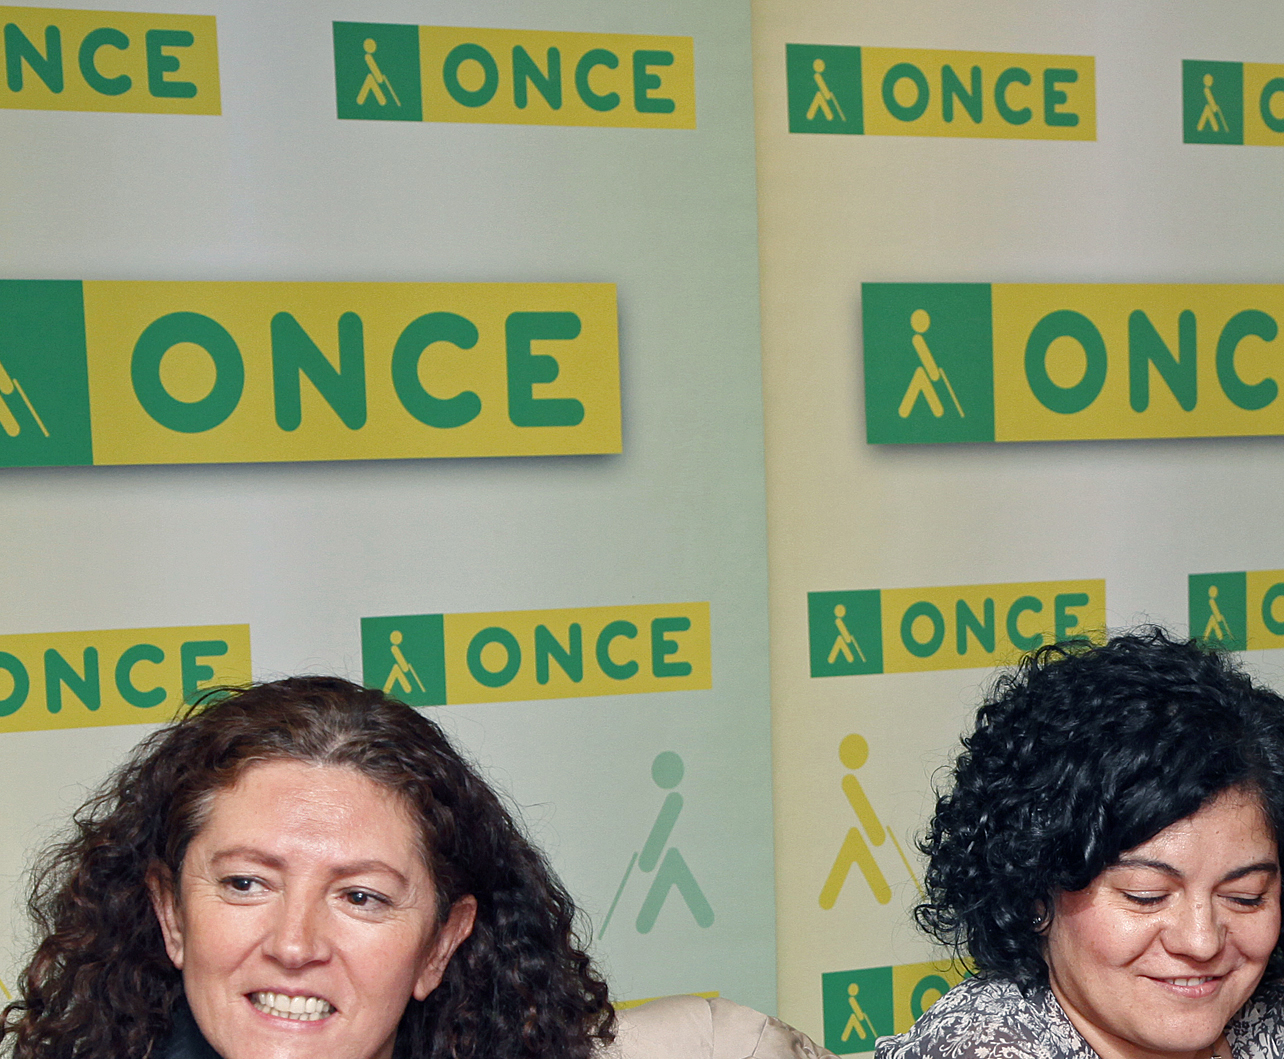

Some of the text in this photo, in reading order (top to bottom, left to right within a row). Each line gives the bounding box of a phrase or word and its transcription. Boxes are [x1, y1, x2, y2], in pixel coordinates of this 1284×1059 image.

[442, 42, 676, 114] ONCE
[881, 62, 1080, 127] ONCE
[130, 310, 586, 434] ONCE
[466, 616, 693, 688] ONCE
[901, 593, 1090, 658] ONCE
